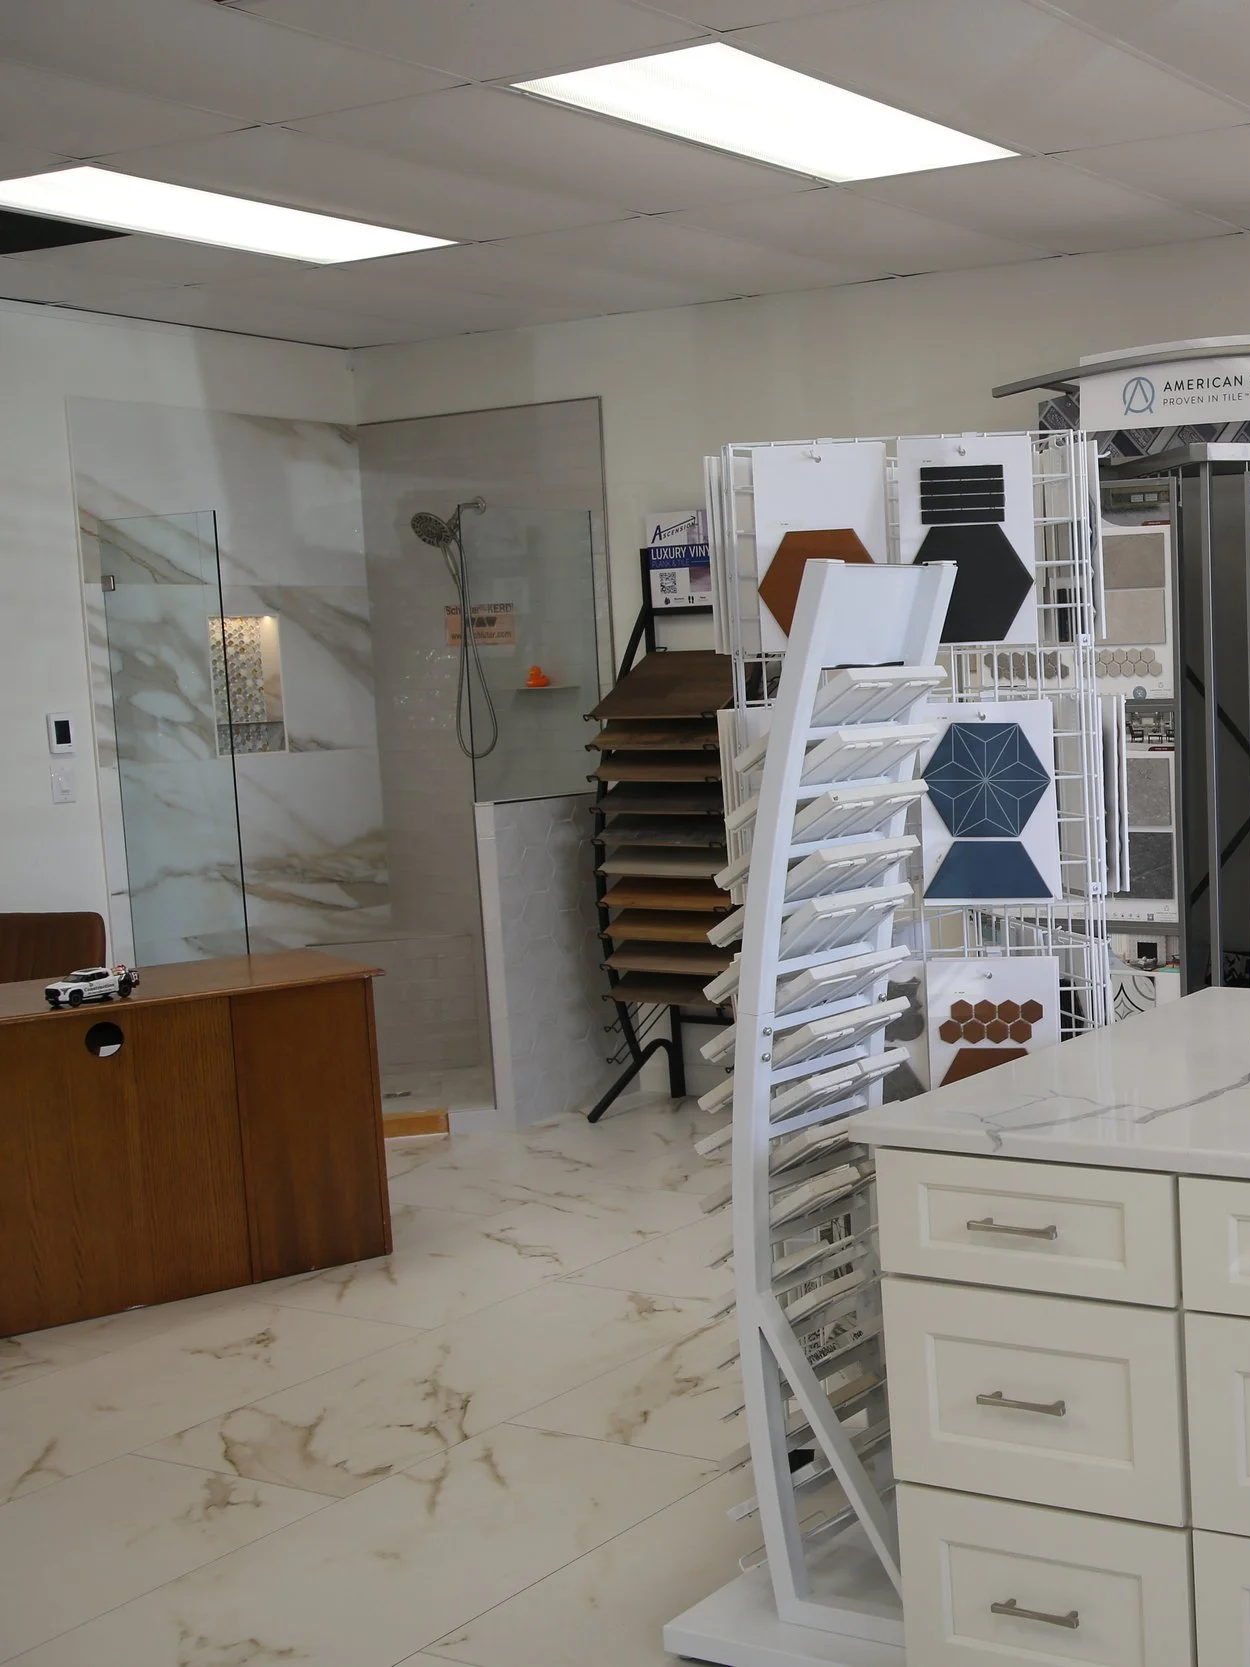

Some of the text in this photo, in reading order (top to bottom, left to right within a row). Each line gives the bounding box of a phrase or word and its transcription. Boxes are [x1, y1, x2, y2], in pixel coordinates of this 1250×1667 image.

[1163, 374, 1244, 392] AMERICAN
[1163, 396, 1204, 406] PROVEN
[1208, 394, 1219, 403] IN
[651, 522, 696, 544] ASCENSION
[651, 545, 711, 560] LUXURY VINY
